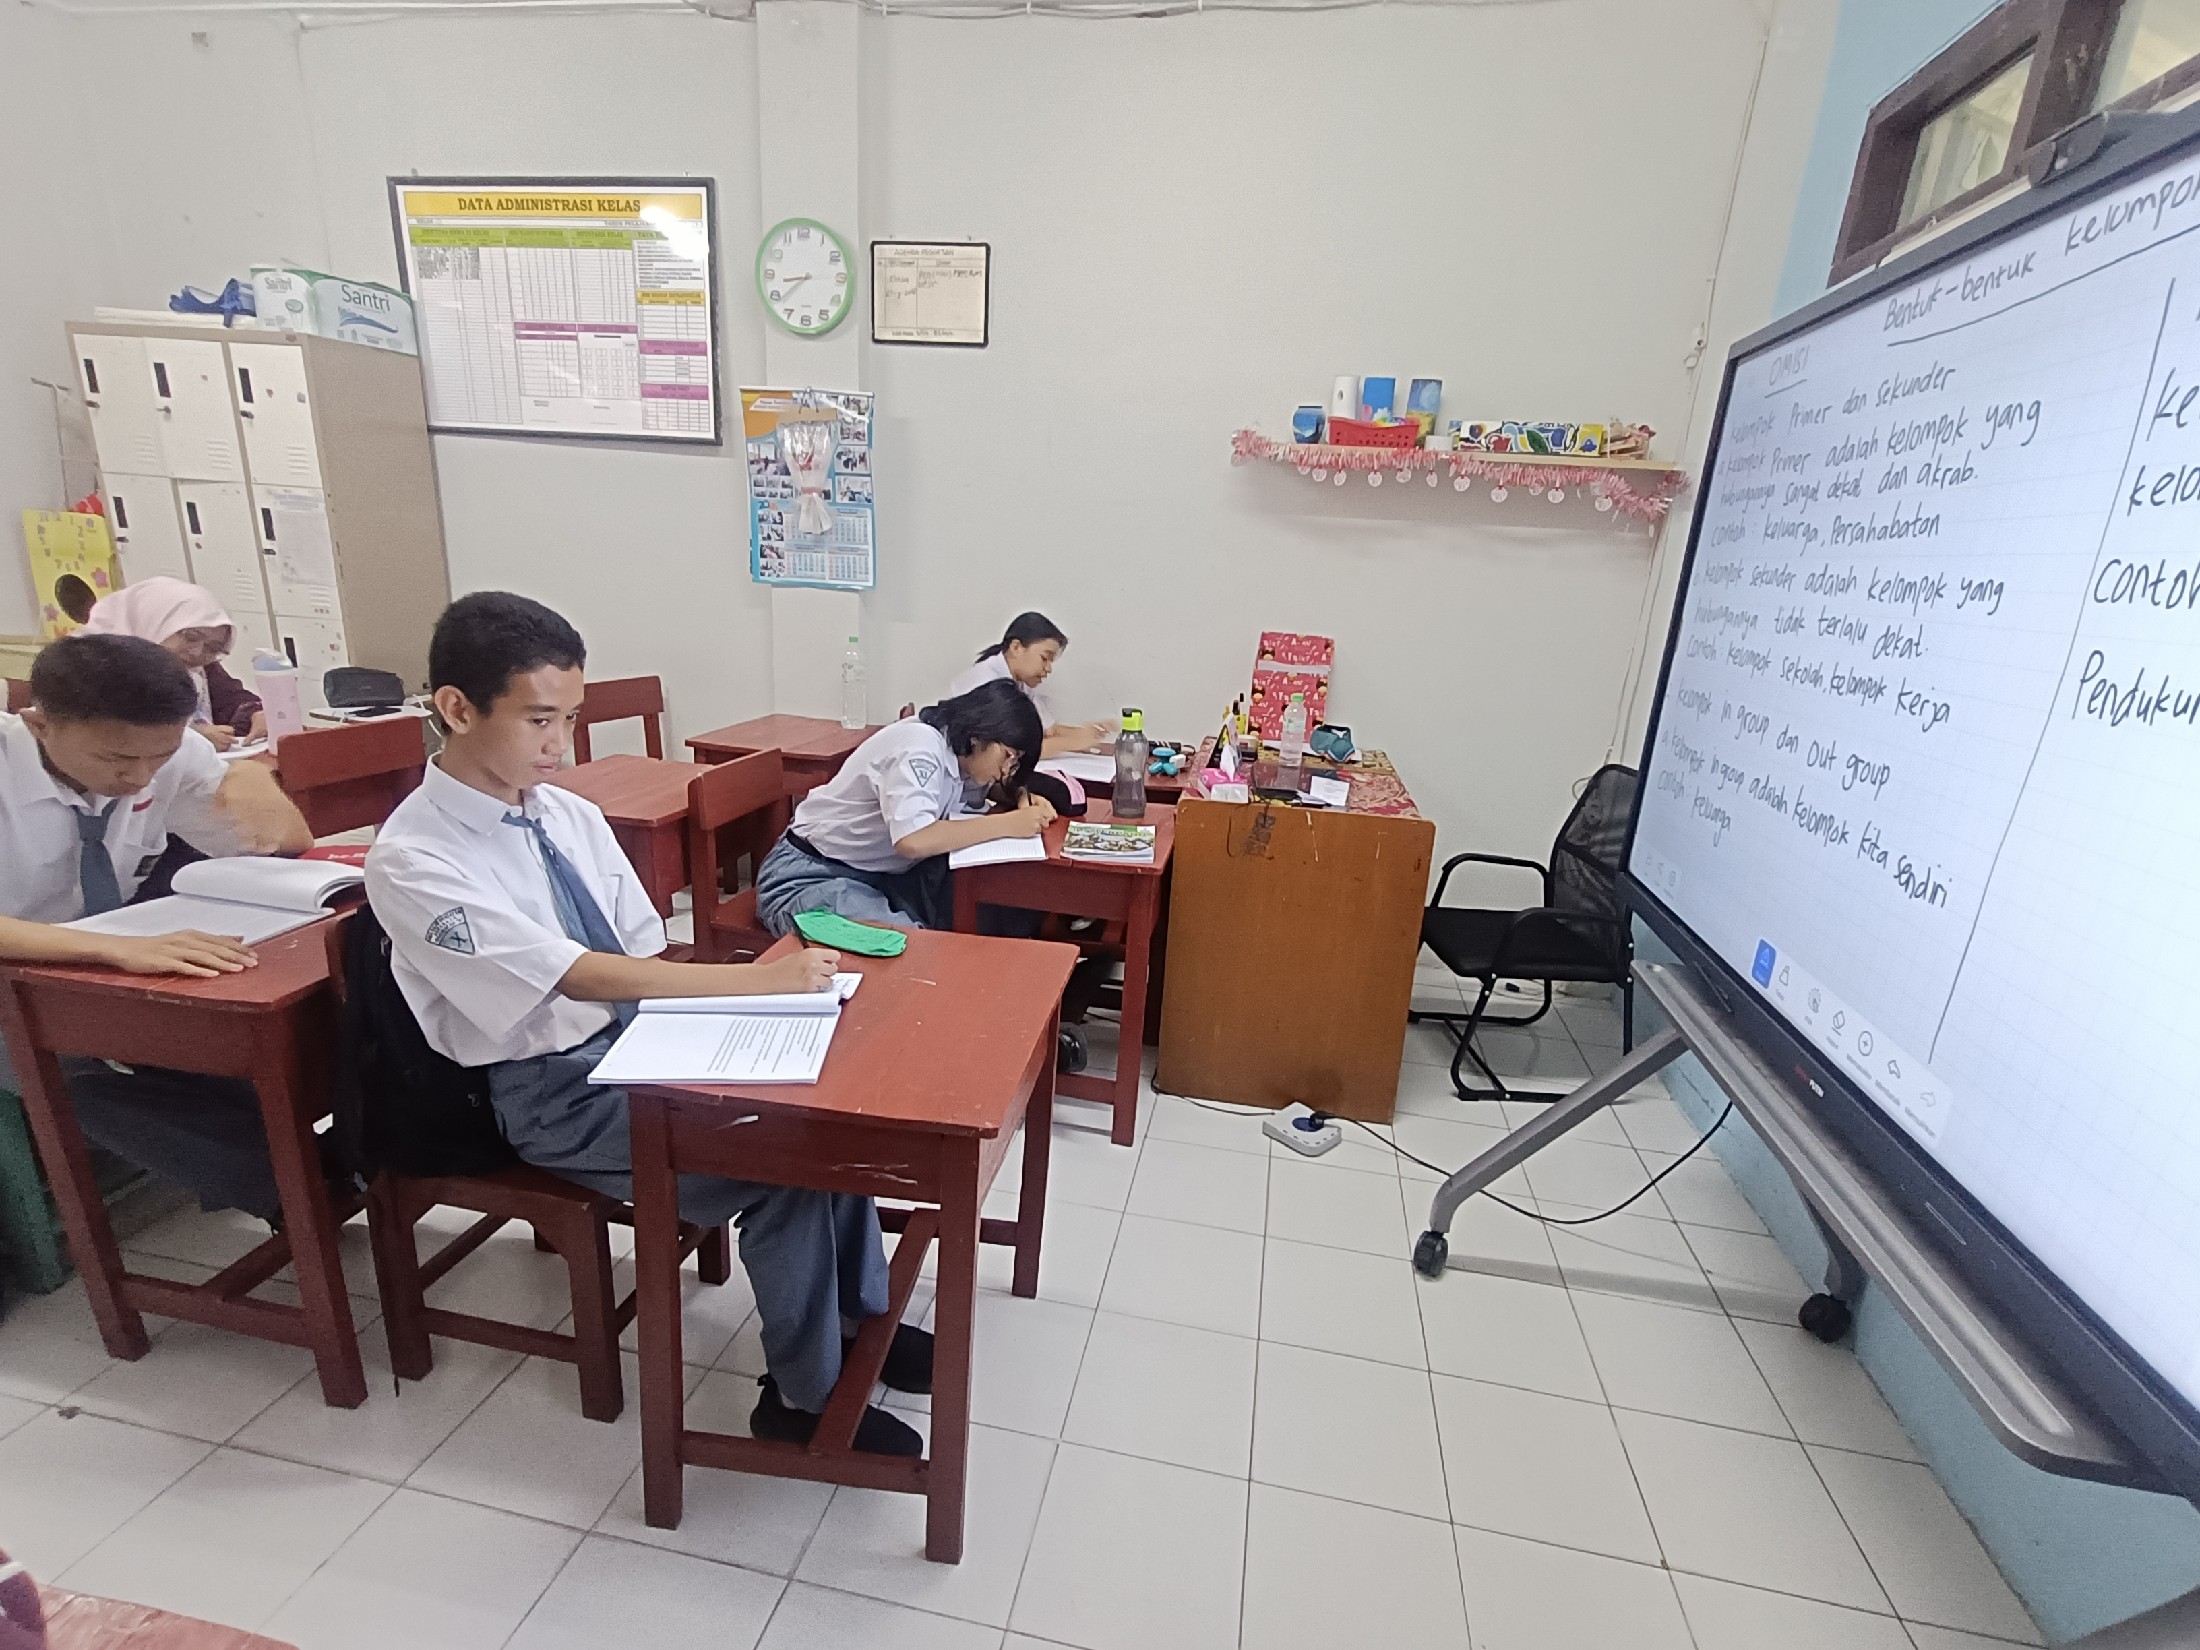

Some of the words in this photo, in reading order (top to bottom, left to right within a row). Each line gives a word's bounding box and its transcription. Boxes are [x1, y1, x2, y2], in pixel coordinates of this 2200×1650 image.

[457, 198, 493, 211] DATA
[496, 198, 593, 212] ADMINISTRASI
[596, 199, 641, 212] KELAS
[341, 284, 391, 313] Santri
[770, 290, 781, 301] 8
[1883, 251, 2037, 332] Bentuk-bentuk
[784, 308, 795, 320] 7
[800, 315, 812, 327] 6
[818, 309, 829, 321] 5
[1842, 387, 1867, 414] dan
[1825, 426, 1878, 467] adalah
[1980, 400, 2041, 450] yang
[1878, 462, 1908, 494] dan
[2127, 464, 2200, 517] kelo
[1804, 562, 1857, 597] adalah
[1867, 566, 1947, 616] kelompok
[1957, 576, 2005, 616] yang
[1774, 605, 1805, 636] tidak
[1817, 604, 1868, 645] terlalu
[1829, 662, 1887, 706] kelompok
[1895, 676, 1950, 733] kerja
[1734, 704, 1770, 745] group
[1776, 724, 1799, 753] dan
[1842, 753, 1890, 801] group
[1792, 785, 1849, 847] kelompok
[1857, 820, 1888, 870] kita
